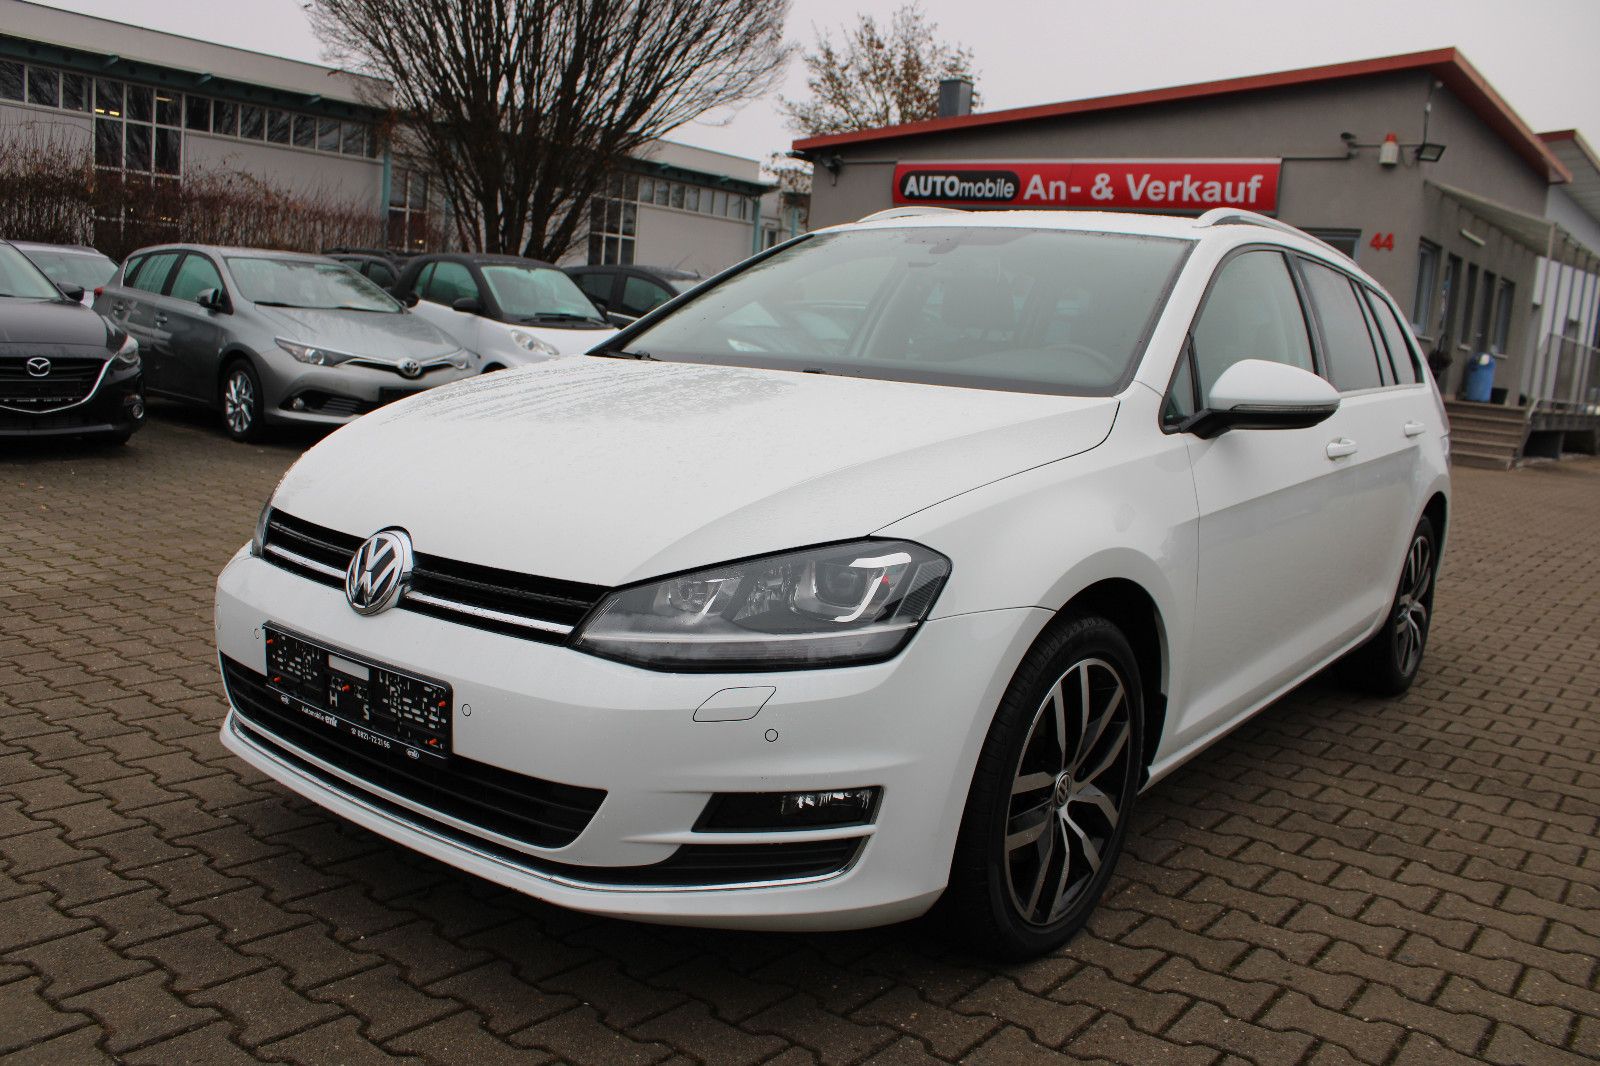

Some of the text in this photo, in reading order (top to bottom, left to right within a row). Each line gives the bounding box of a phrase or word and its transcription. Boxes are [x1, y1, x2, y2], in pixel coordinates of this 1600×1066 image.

[904, 173, 1263, 203] AUTOmobile An- & Verkauf
[1369, 232, 1394, 251] 44
